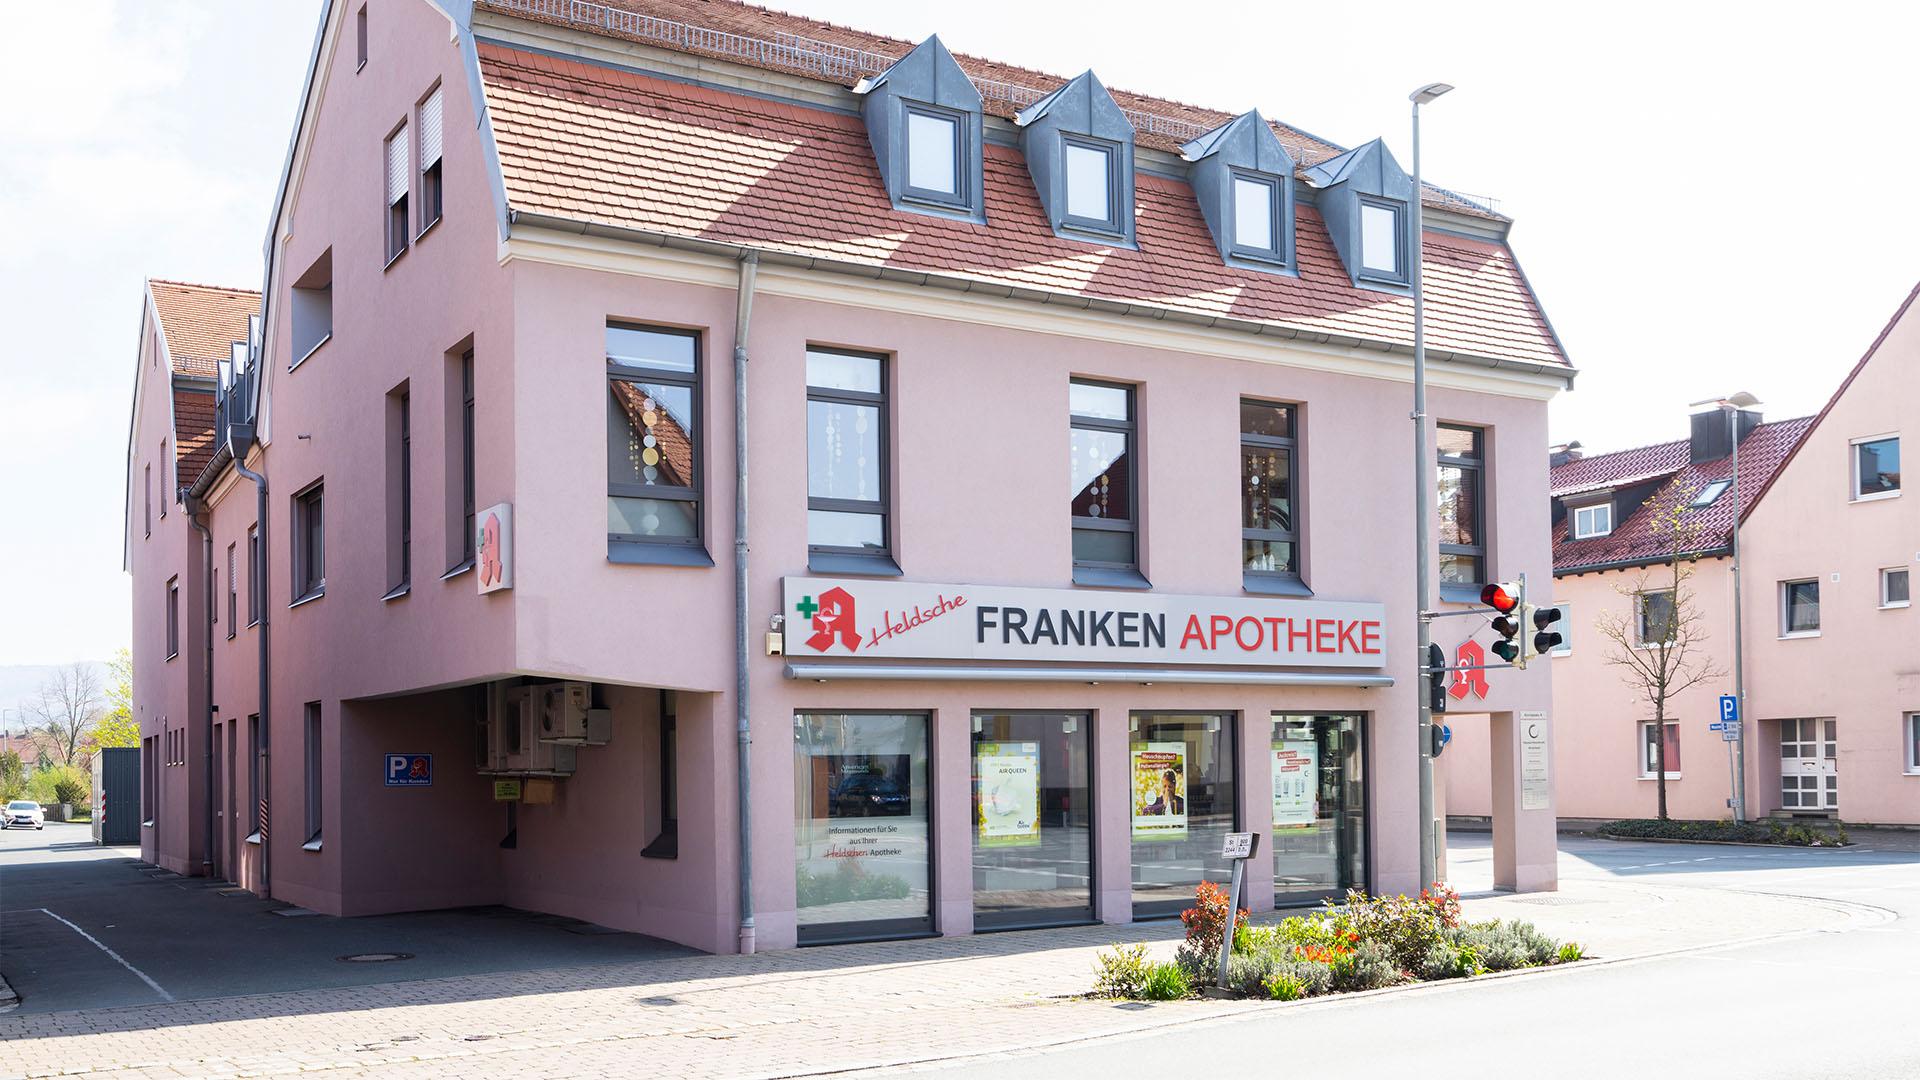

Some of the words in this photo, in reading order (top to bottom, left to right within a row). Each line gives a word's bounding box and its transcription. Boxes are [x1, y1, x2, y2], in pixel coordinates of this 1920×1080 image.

[866, 594, 968, 648] Heldsche
[976, 605, 1166, 649] FRANKEN
[1179, 613, 1381, 654] APOTHEKE
[1723, 699, 1734, 719] P
[390, 756, 408, 778] P
[828, 826, 876, 835] Informationen
[877, 825, 887, 833] für
[870, 847, 902, 857] Apotheke
